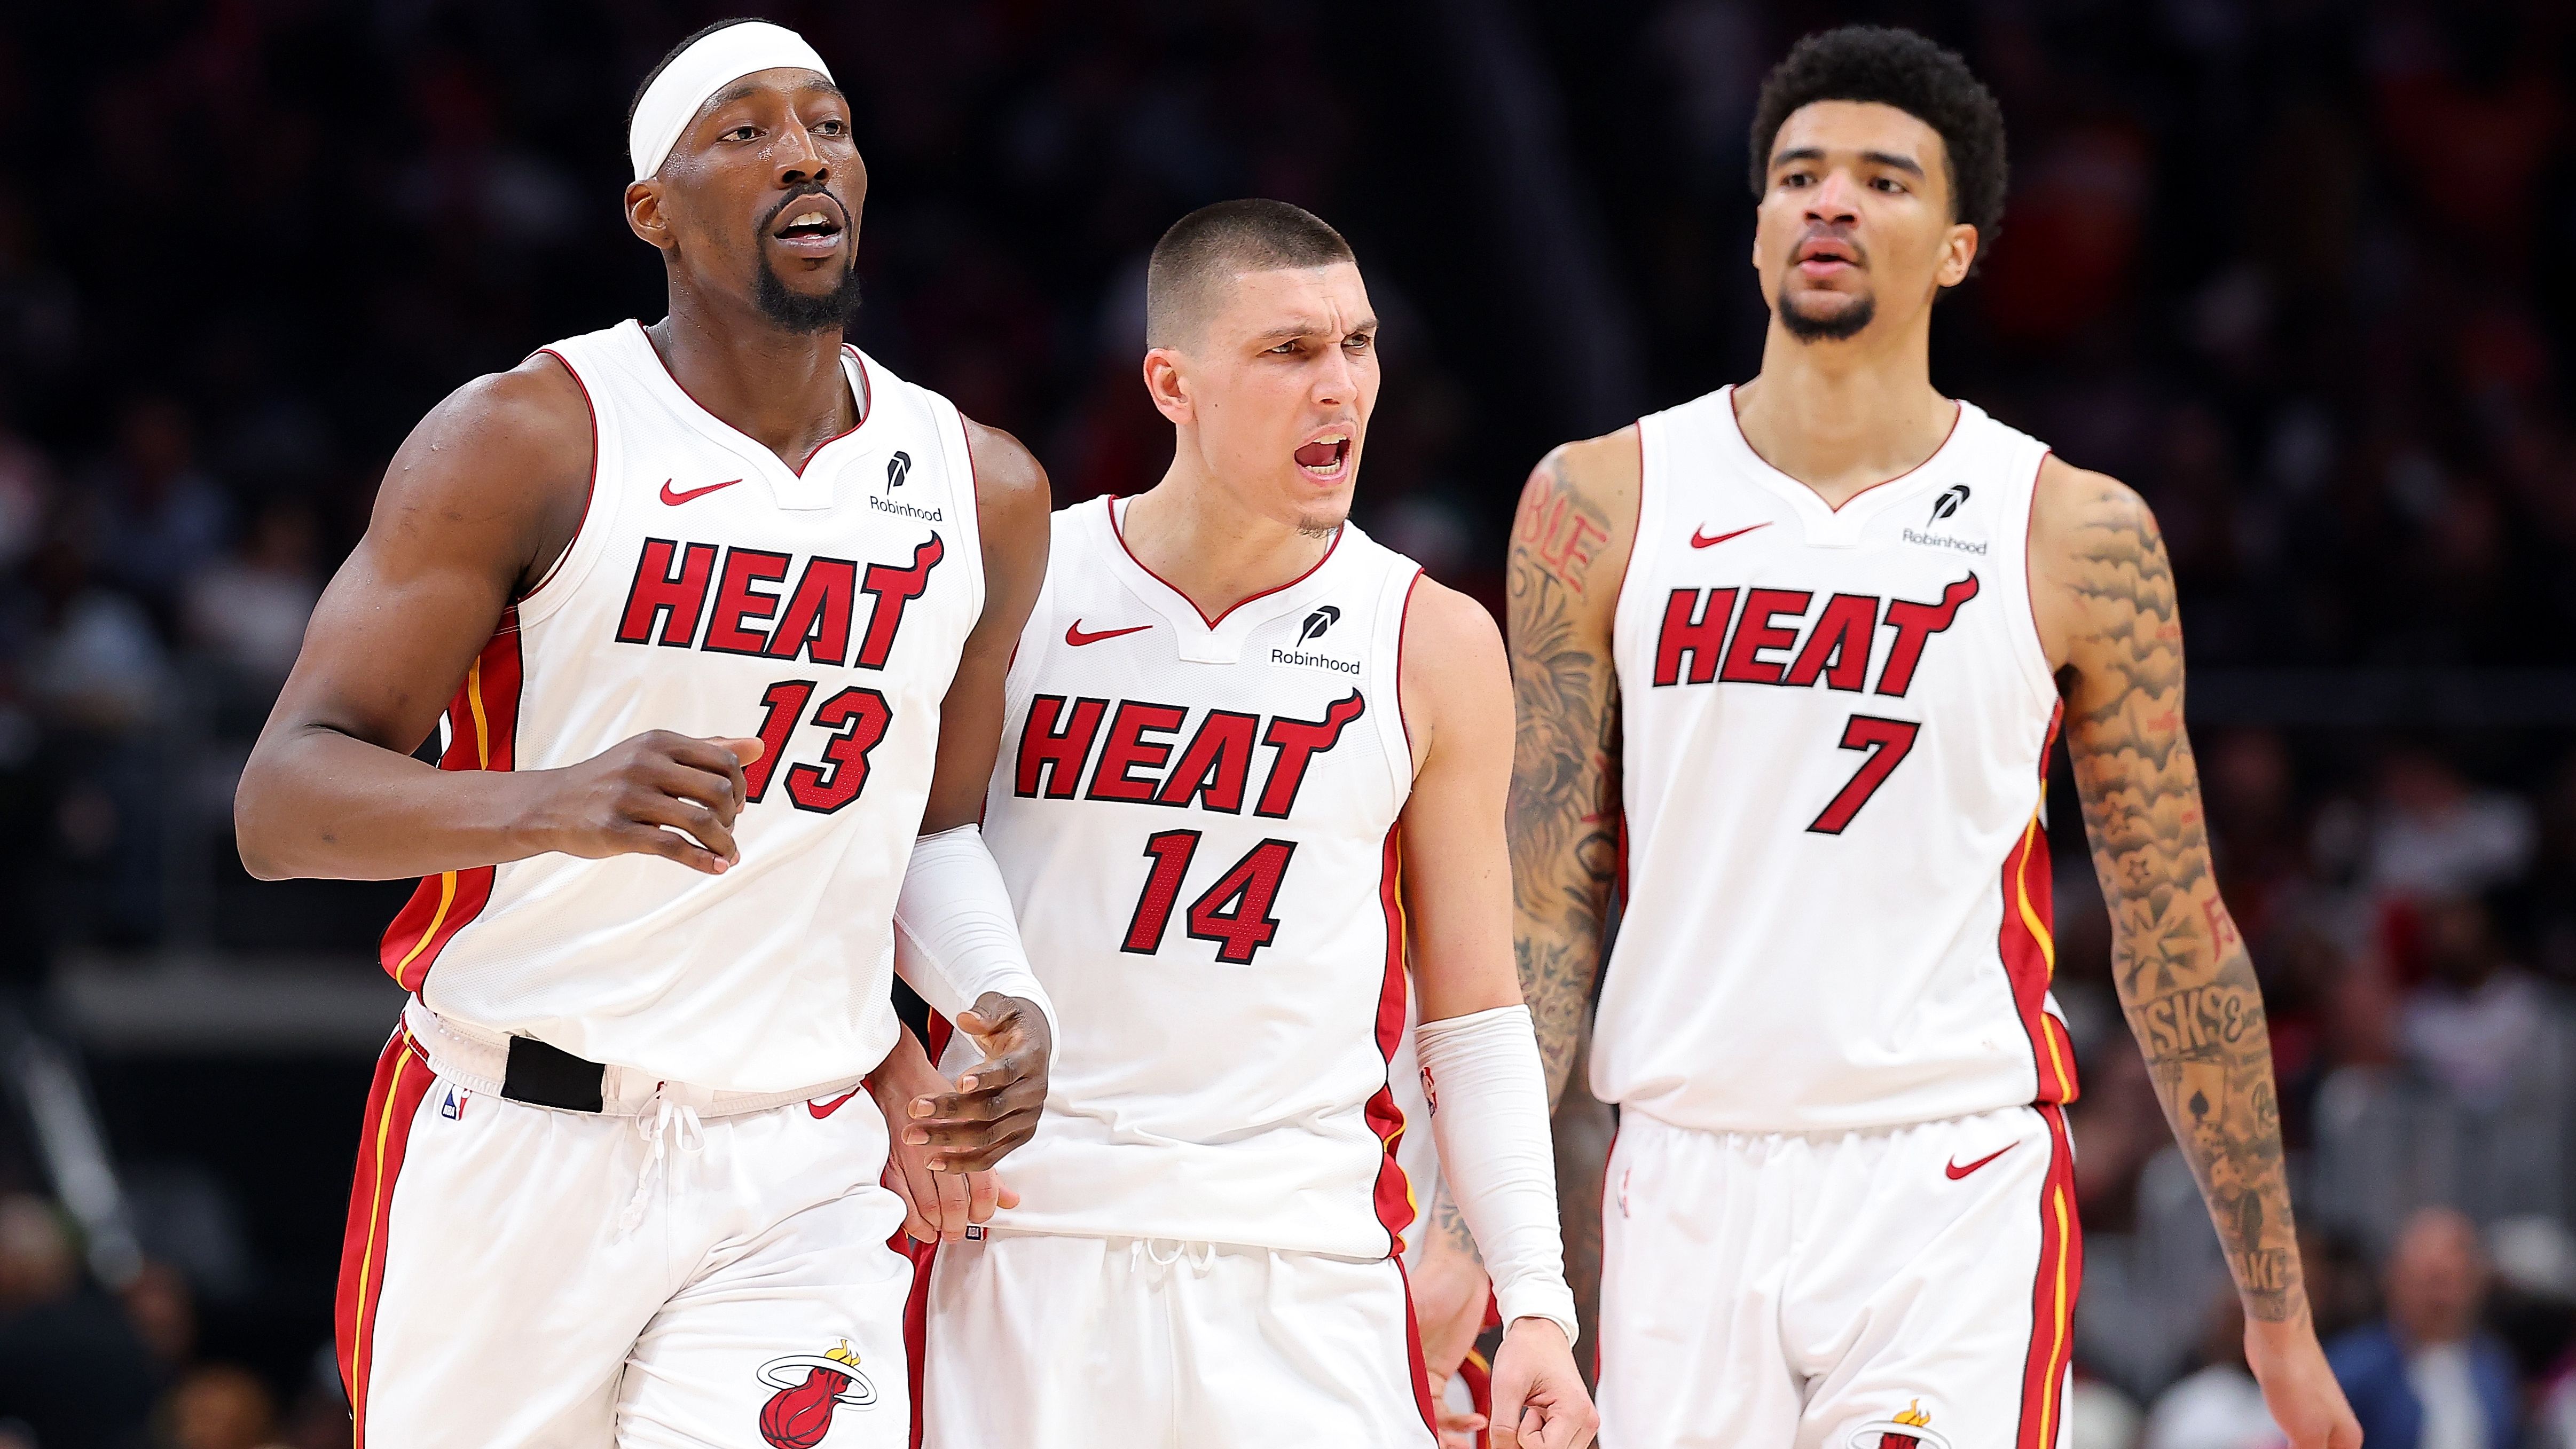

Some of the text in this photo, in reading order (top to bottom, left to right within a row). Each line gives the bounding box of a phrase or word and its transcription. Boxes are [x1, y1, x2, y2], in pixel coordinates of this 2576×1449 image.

[870, 495, 943, 522] Robinhood
[1902, 528, 1988, 556] Robinhood
[614, 530, 944, 671] HEAT
[1271, 649, 1360, 675] Robinhood
[1653, 570, 1979, 697] HEAT
[743, 680, 893, 815] 13
[1015, 687, 1365, 819] HEAT
[1805, 714, 1921, 835] 7
[1120, 829, 1298, 965] 14
[443, 1104, 455, 1117] NBA
